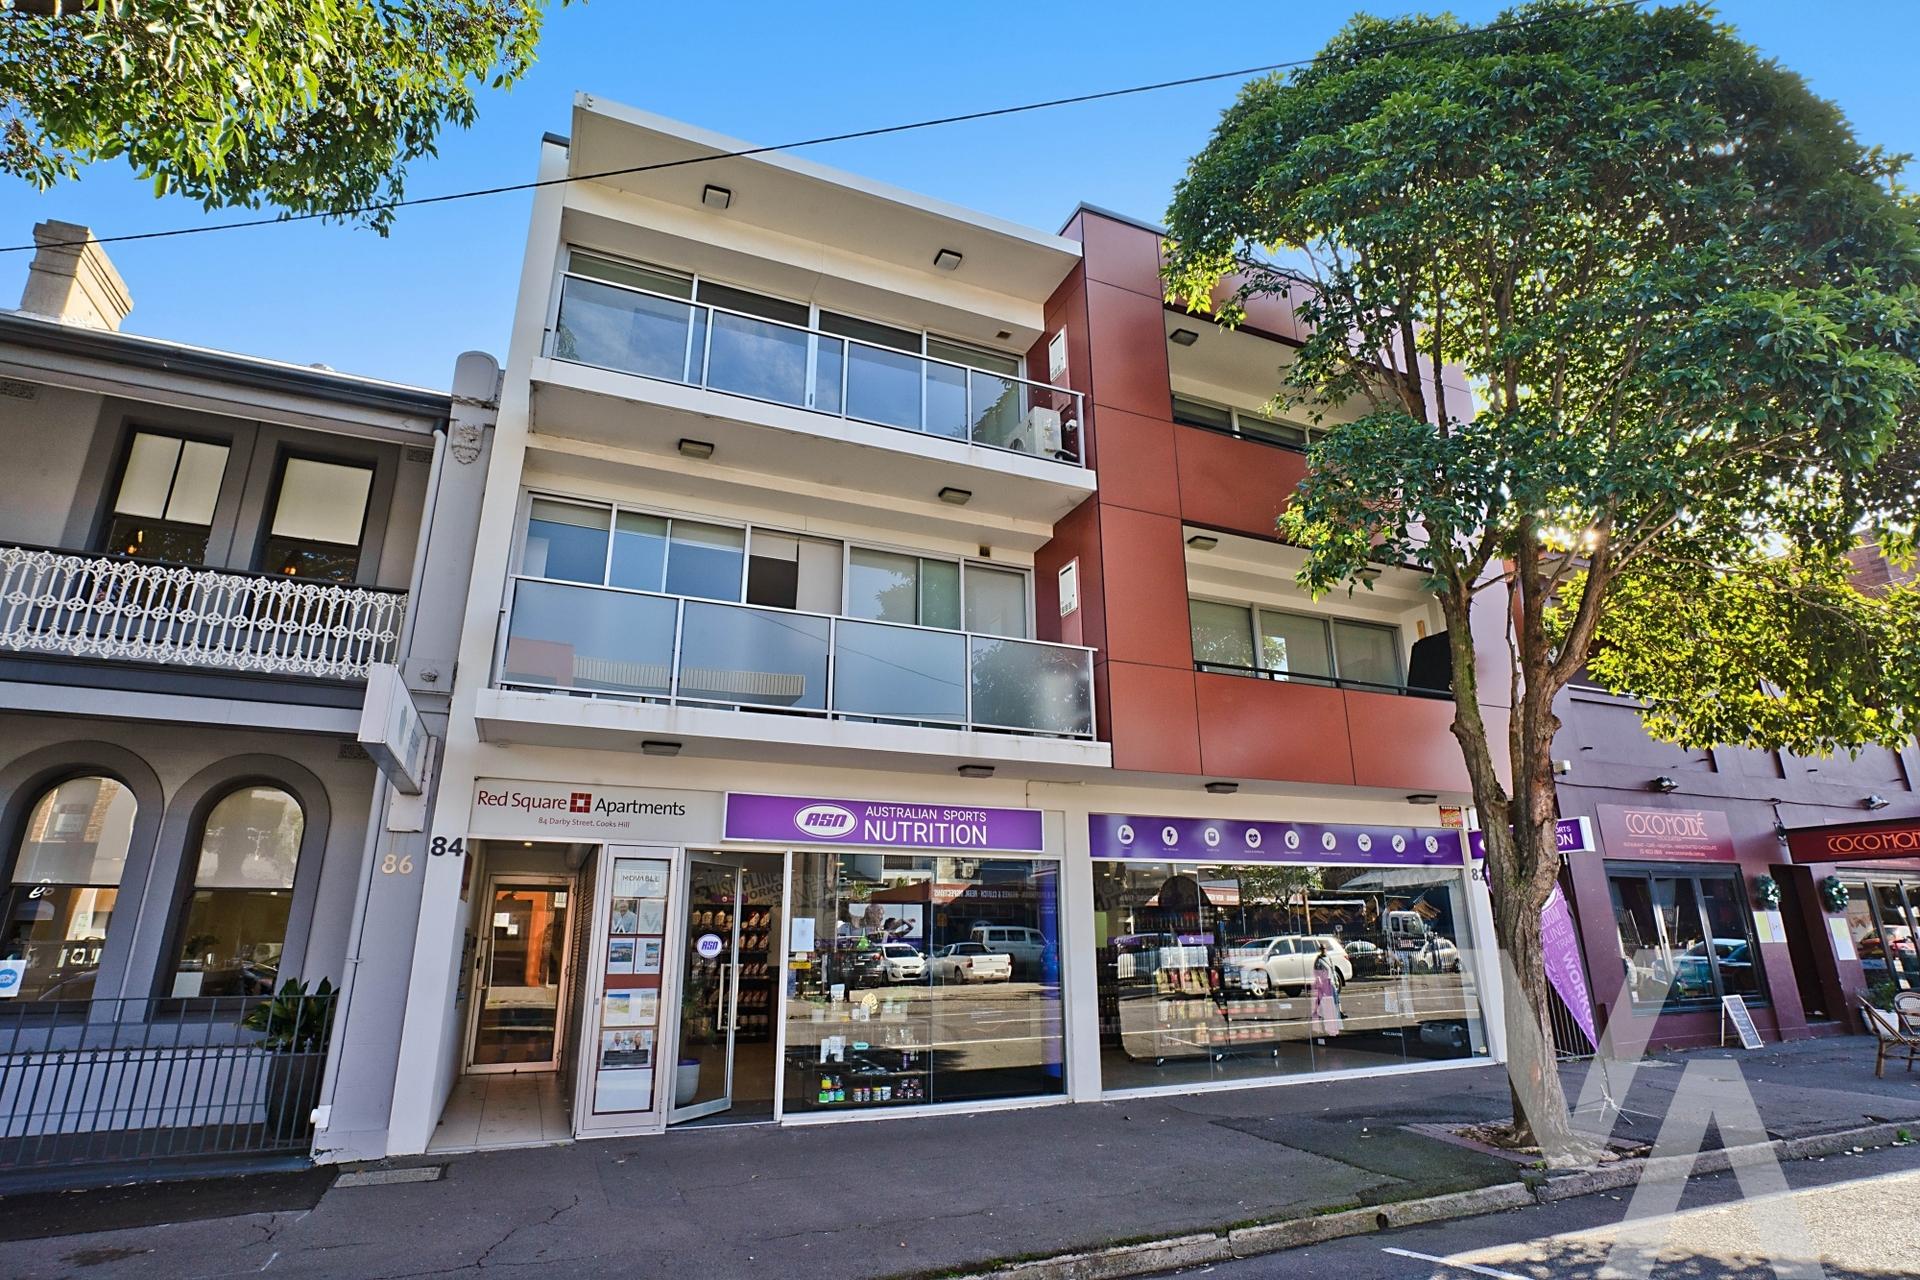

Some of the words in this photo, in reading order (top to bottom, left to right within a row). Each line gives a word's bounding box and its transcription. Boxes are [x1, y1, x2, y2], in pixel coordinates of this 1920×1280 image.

[476, 790, 508, 807] Red
[512, 792, 567, 813] Square
[594, 797, 686, 817] Apartments
[538, 817, 548, 825] 84
[549, 817, 571, 827] Darby
[596, 820, 617, 828] Cooks
[618, 820, 630, 829] Hill
[804, 812, 847, 828] ASN
[865, 806, 937, 820] AUSTRALIAN
[943, 810, 987, 822] SPORTS
[864, 820, 987, 845] NUTRITION
[430, 836, 464, 858] 84
[381, 854, 414, 874] 86
[701, 941, 719, 950] ASN
